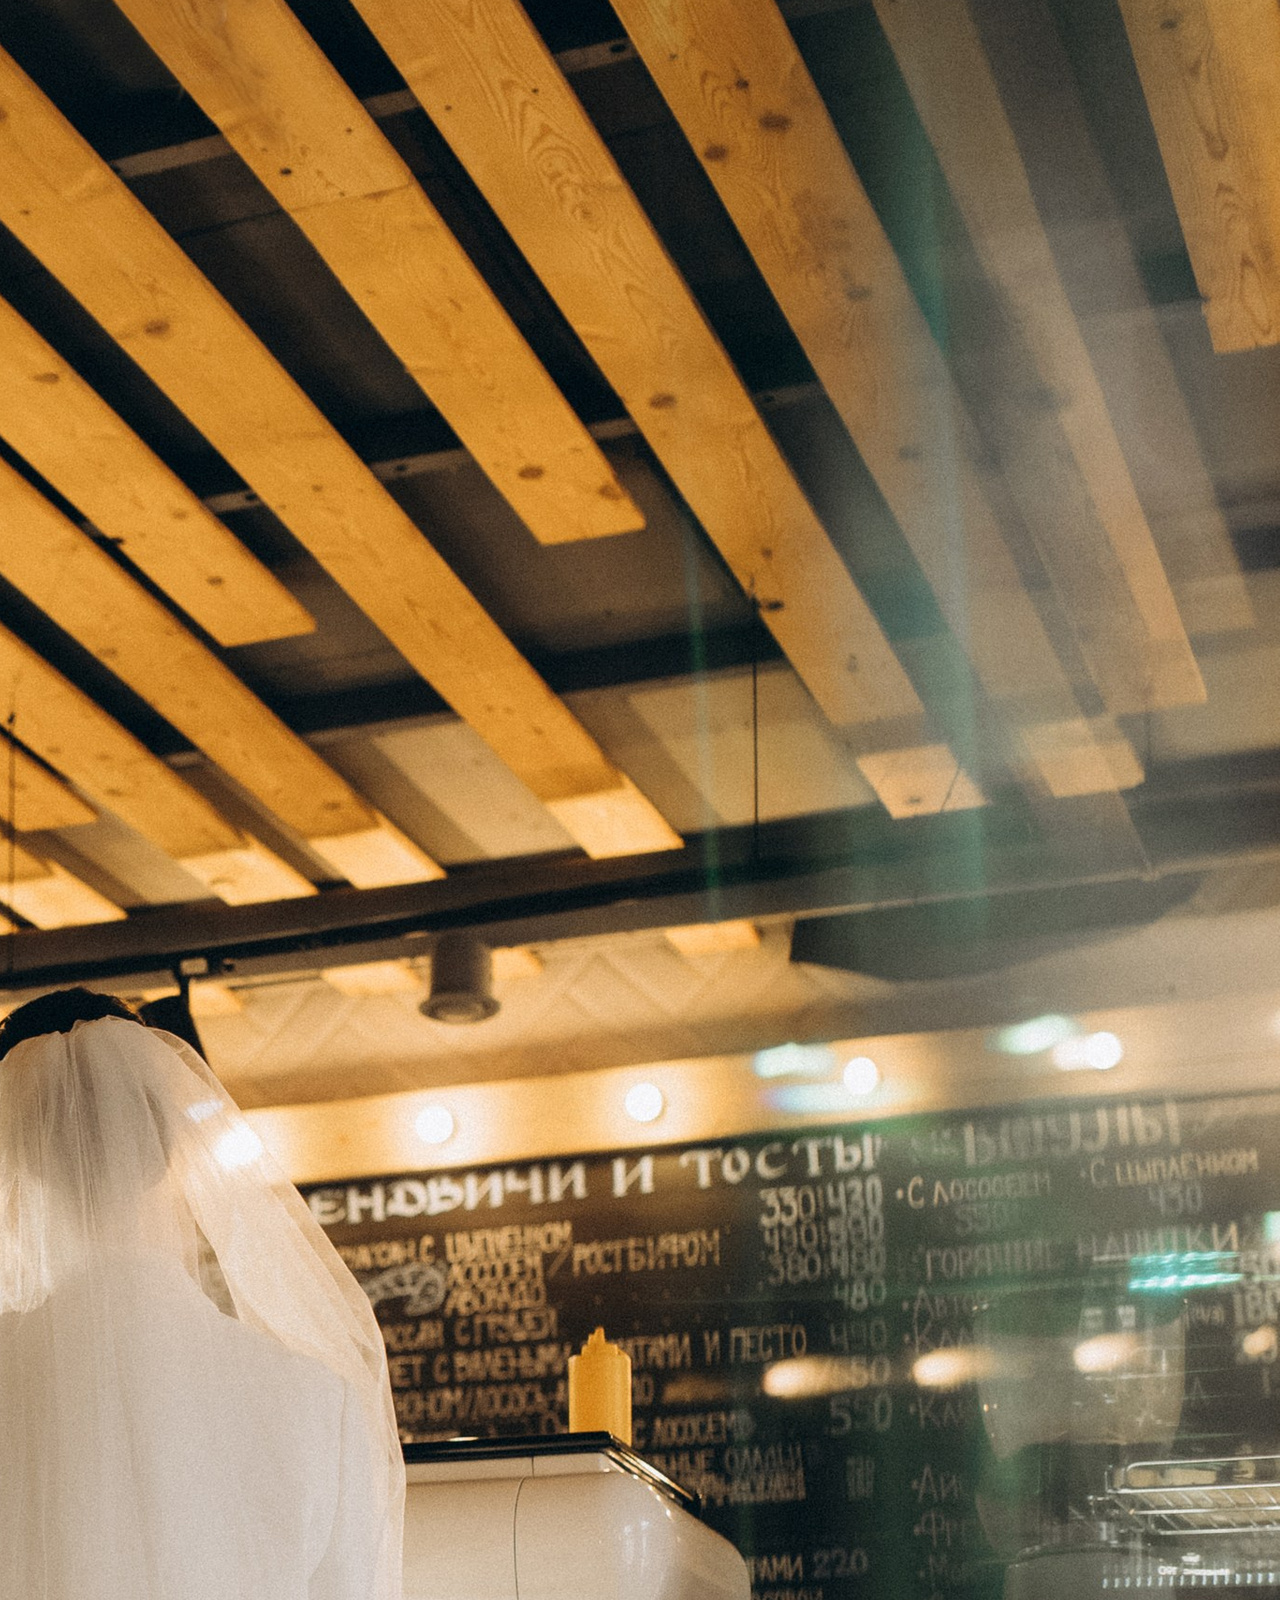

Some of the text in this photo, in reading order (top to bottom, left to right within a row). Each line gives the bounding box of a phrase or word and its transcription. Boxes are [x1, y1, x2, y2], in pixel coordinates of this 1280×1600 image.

[311, 1133, 878, 1226] ЕНДВИЧИ И ТОСТЫ
[908, 1176, 925, 1209] С
[730, 1323, 808, 1363] ПЕСТО
